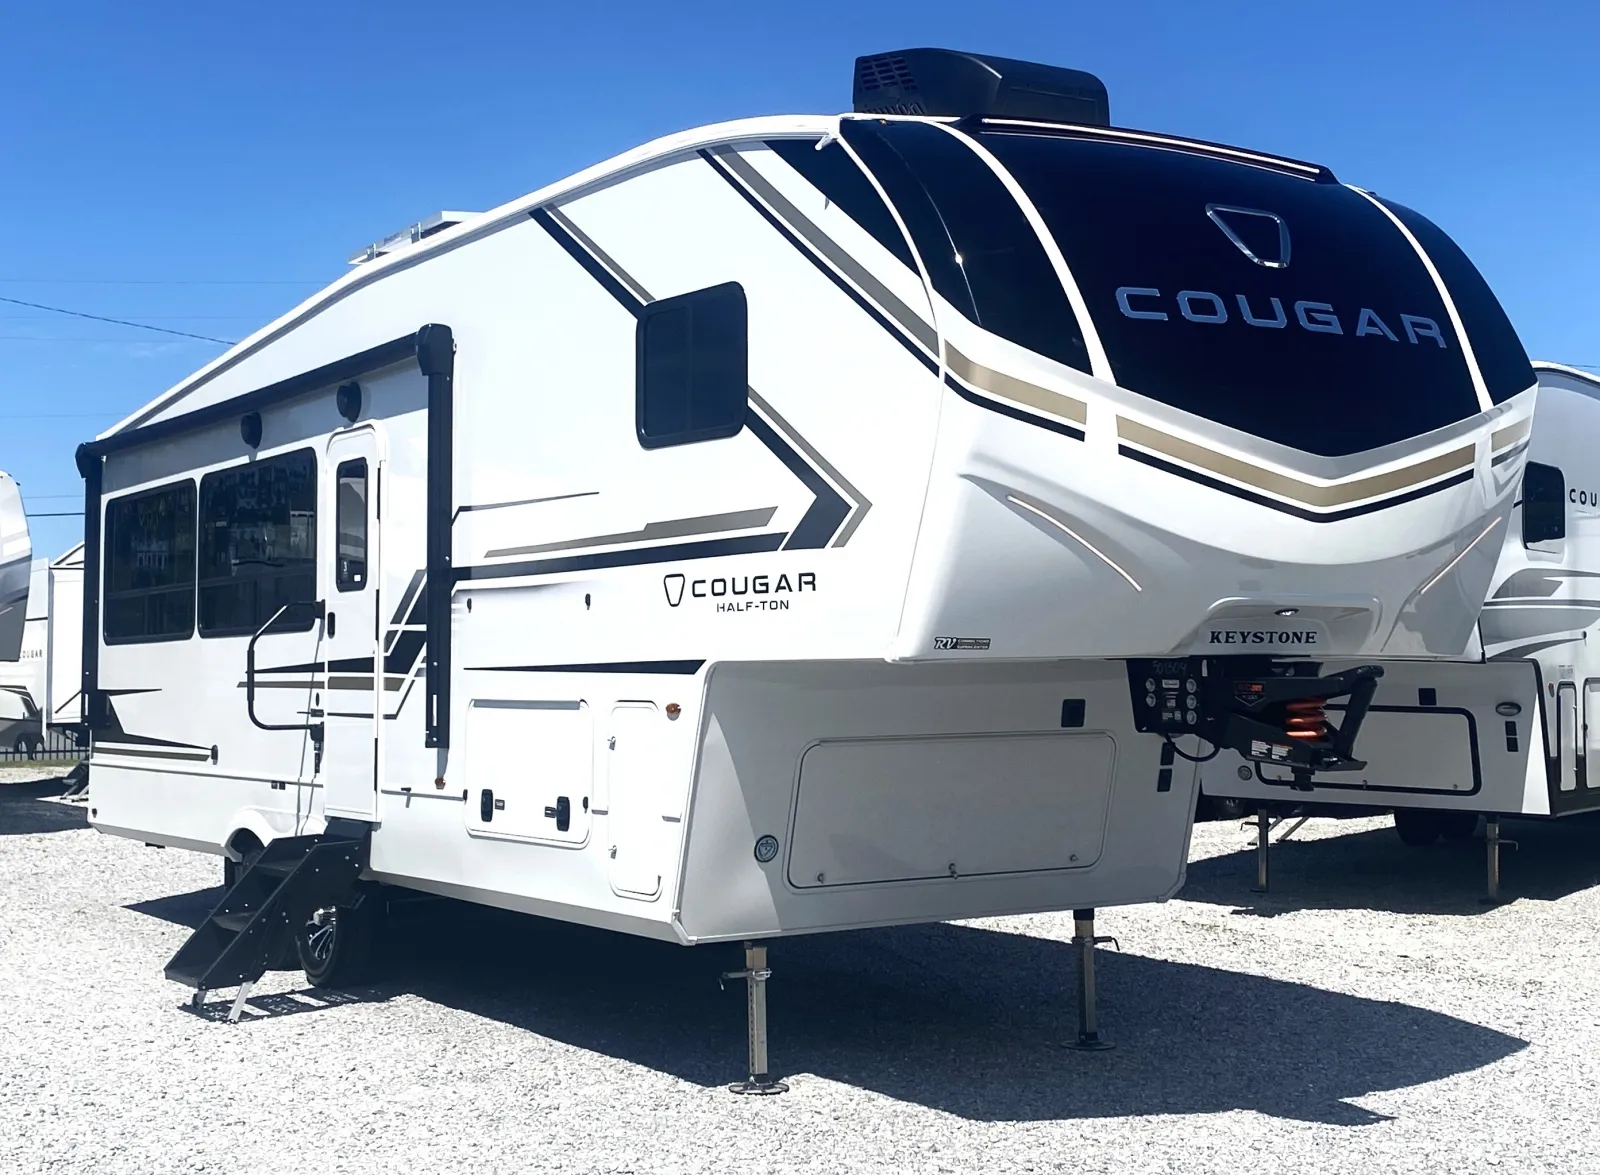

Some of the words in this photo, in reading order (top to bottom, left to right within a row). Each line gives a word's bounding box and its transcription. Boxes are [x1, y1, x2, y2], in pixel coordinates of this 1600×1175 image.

[1114, 286, 1448, 350] COUGAR
[1569, 488, 1598, 507] COU
[692, 572, 817, 598] COUGAR
[716, 599, 789, 613] HALF-TON
[934, 637, 957, 649] RV
[1209, 630, 1318, 644] KEYSTONE
[20, 649, 43, 659] OUGAR
